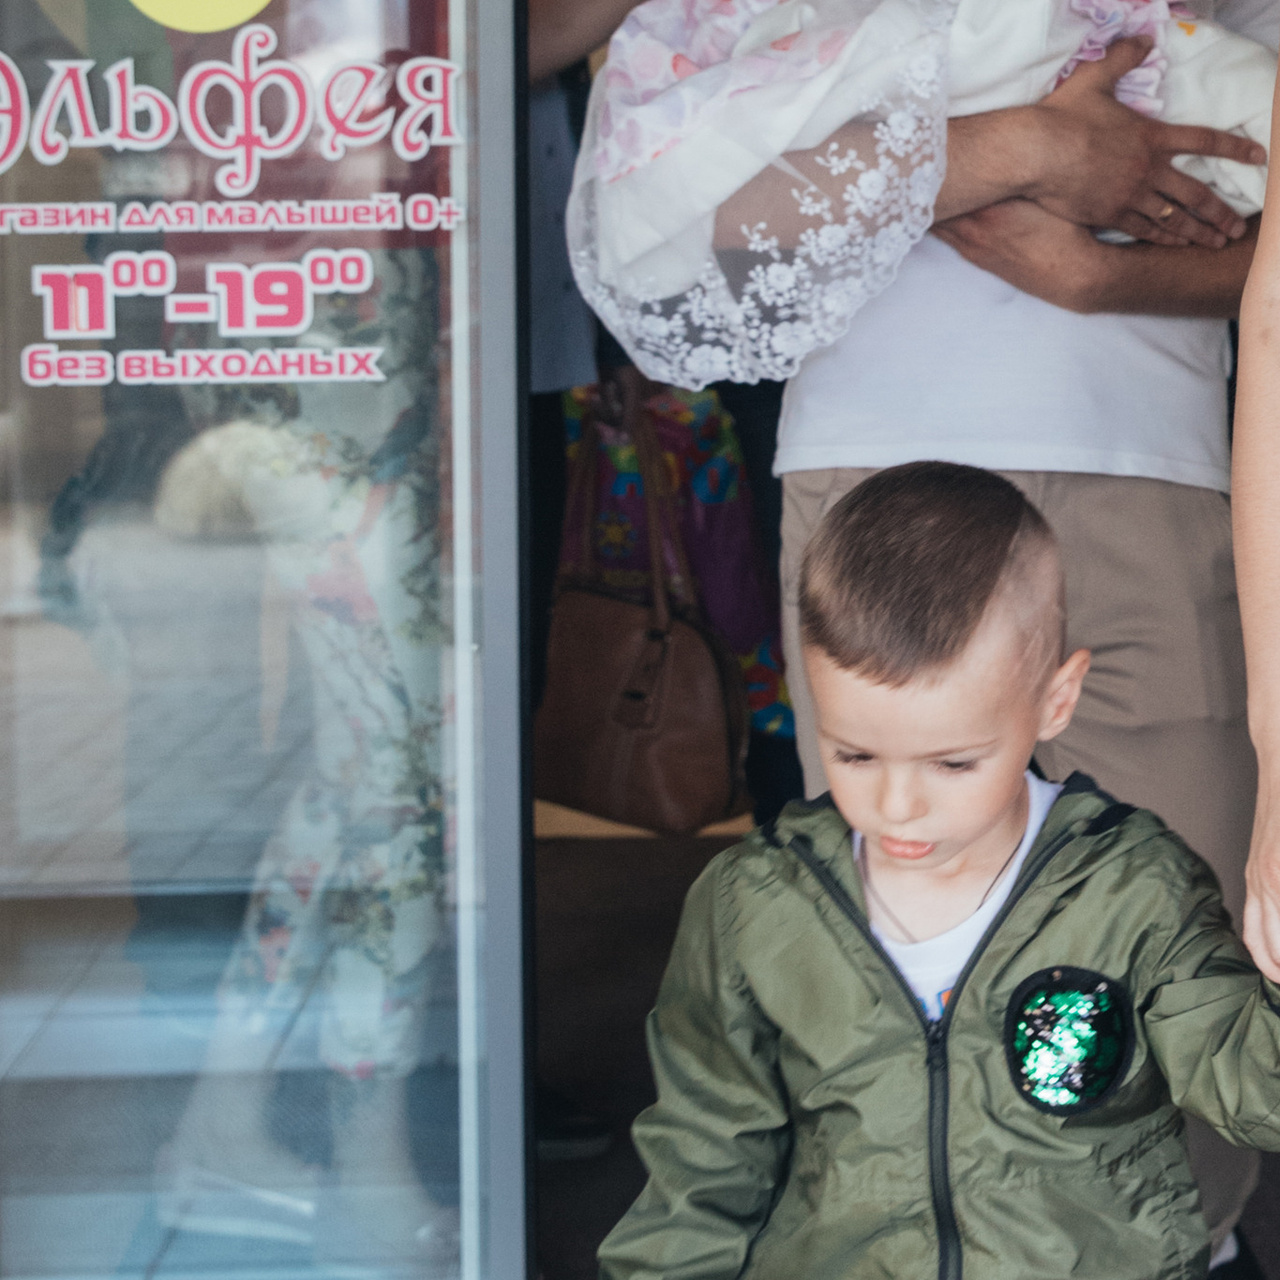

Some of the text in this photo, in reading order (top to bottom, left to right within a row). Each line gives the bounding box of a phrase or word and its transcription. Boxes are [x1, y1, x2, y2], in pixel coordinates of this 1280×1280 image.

[122, 204, 198, 230] для
[204, 196, 400, 228] малышей
[24, 347, 381, 383] без выходных
